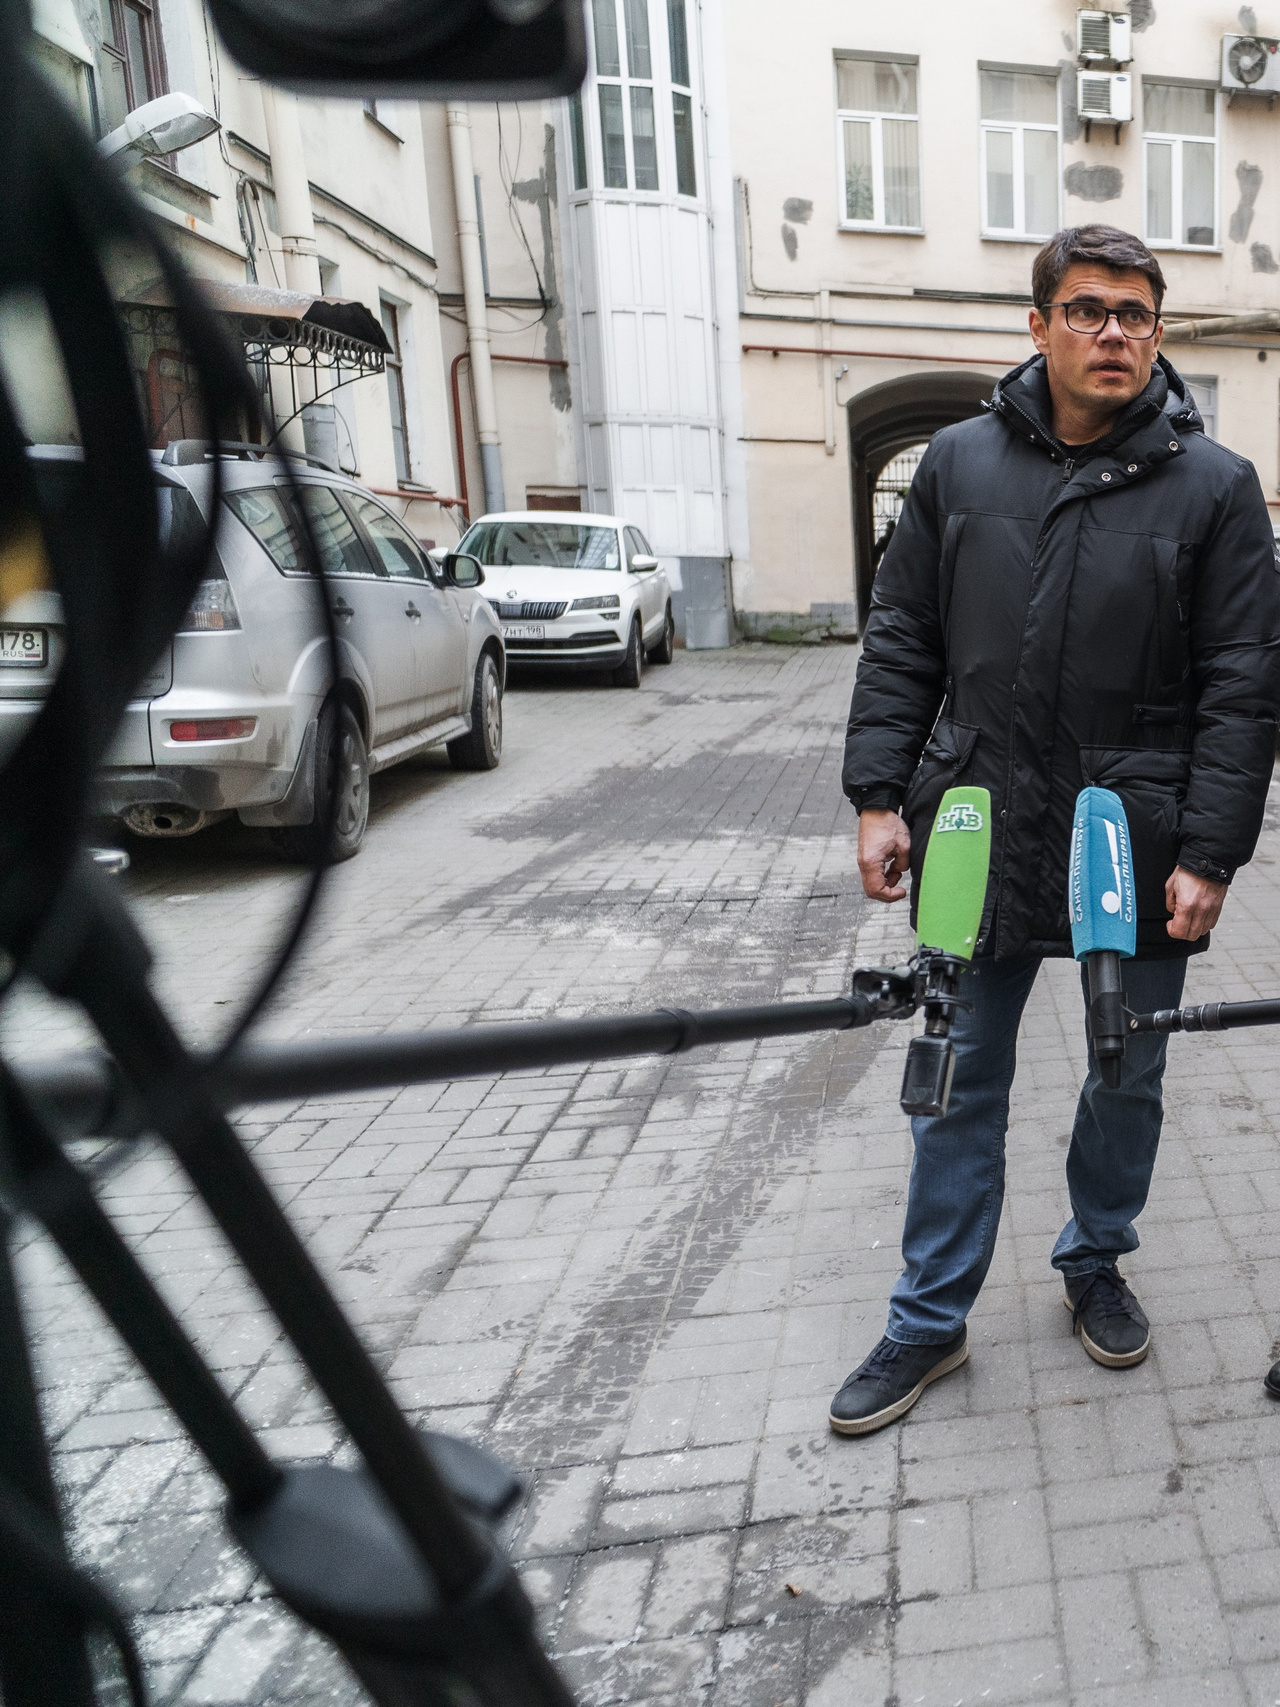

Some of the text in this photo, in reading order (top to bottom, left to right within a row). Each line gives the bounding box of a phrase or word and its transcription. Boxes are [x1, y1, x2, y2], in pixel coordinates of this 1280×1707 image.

[0, 632, 35, 650] 178
[938, 805, 980, 830] НТВ
[1073, 817, 1084, 922] САНКТ-ПЕТЕРБУРГ
[1118, 819, 1133, 923] САНКТ-ПЕТЕРБУРГ
